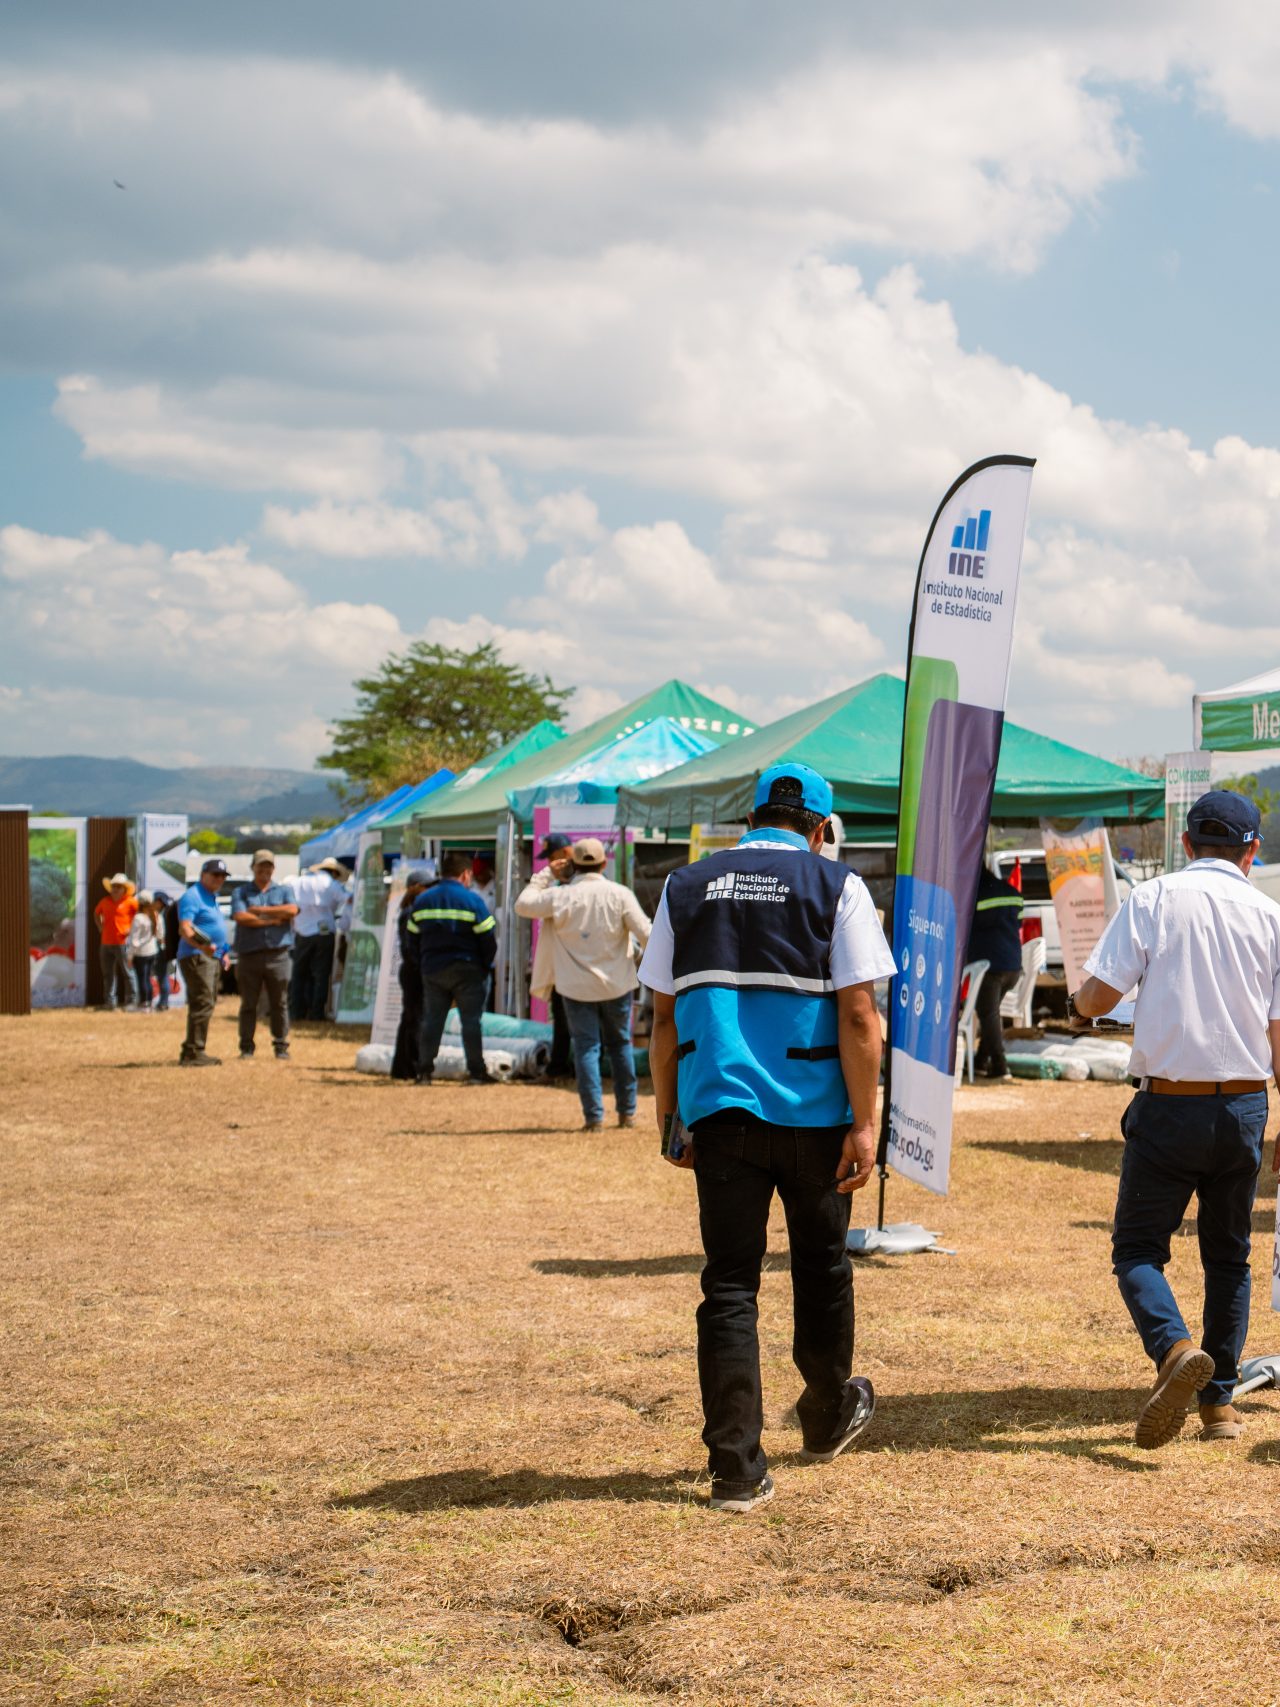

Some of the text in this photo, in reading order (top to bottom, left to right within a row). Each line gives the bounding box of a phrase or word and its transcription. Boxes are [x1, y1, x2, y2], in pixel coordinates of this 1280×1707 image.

[948, 552, 985, 579] INE
[923, 580, 1003, 605] Instituto Nacional
[931, 599, 942, 614] de
[736, 873, 779, 883] Instituto
[735, 883, 790, 893] Nacional de
[733, 892, 786, 902] Estadística
